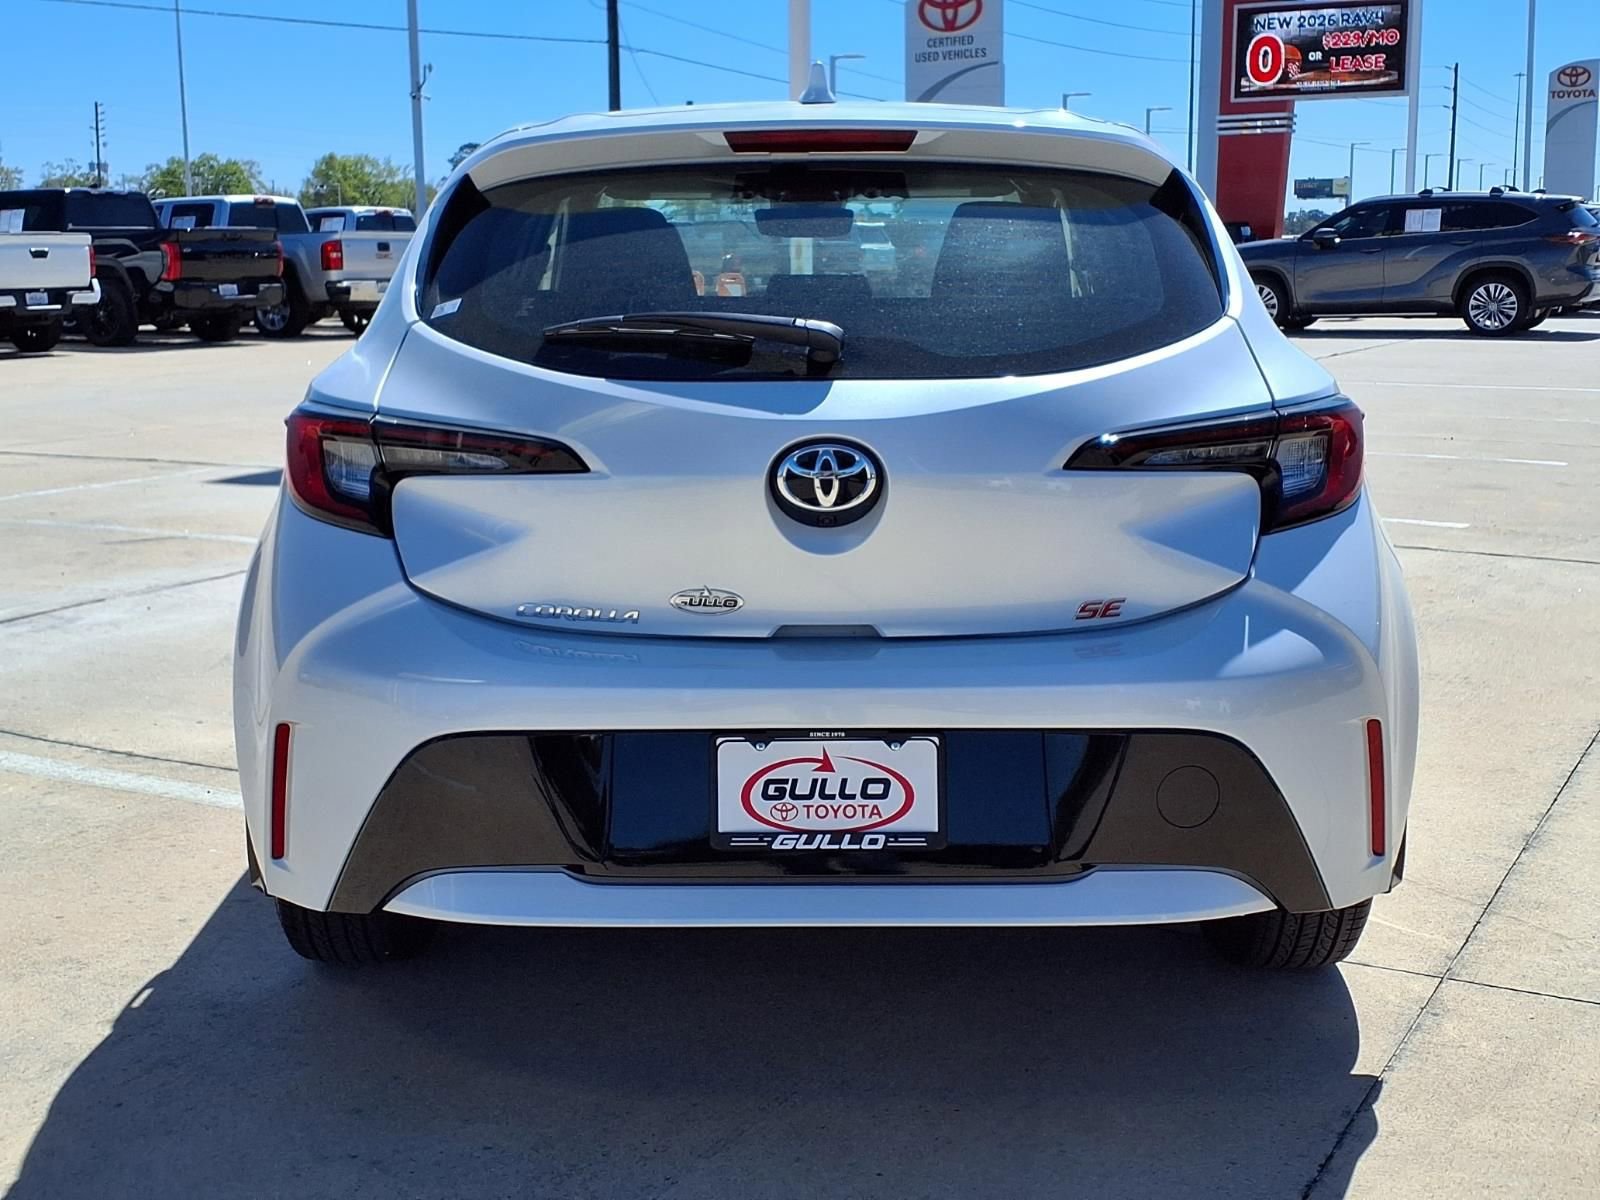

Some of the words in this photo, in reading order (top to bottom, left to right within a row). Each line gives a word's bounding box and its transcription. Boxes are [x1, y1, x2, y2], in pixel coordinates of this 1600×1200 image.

[1254, 16, 1292, 31] NEW
[1297, 13, 1336, 28] 2026
[1341, 10, 1385, 26] RAV4
[926, 35, 974, 48] CERTIFIED
[914, 51, 940, 63] USED
[941, 47, 987, 61] VEHICLES
[1246, 33, 1285, 86] 0
[1308, 51, 1323, 61] OR
[1329, 54, 1386, 73] LEASE
[1551, 89, 1596, 99] TOYOTA
[675, 596, 738, 608] GULLO
[1073, 597, 1127, 620] SE
[516, 602, 640, 624] COROLLA
[760, 778, 892, 801] GULLO
[802, 804, 883, 819] TOYOTA
[771, 834, 887, 850] GULLO
